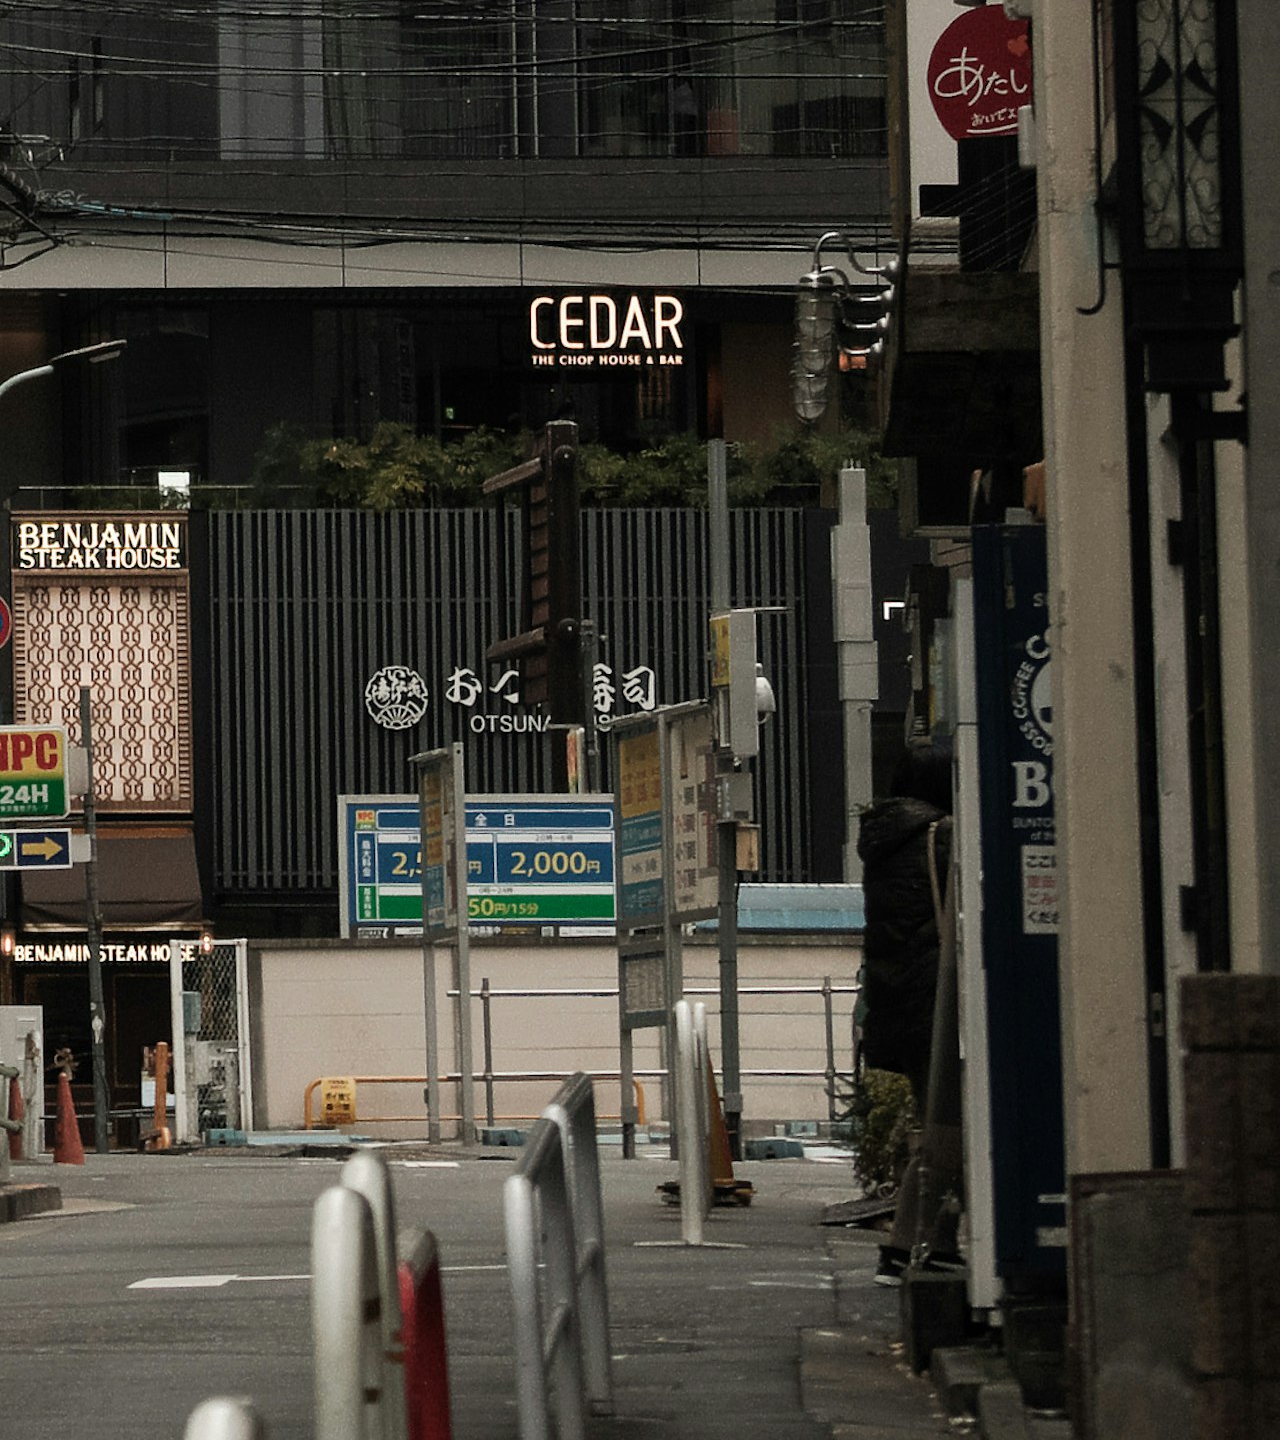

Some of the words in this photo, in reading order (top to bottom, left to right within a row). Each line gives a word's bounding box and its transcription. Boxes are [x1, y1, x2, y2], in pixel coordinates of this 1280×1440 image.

[529, 295, 683, 349] CEDAR
[532, 355, 555, 366] THE
[559, 355, 594, 366] CHOP
[599, 355, 641, 366] HOUSE
[659, 355, 683, 365] BAR
[18, 522, 180, 549] BENJAMIN
[19, 548, 100, 569] STEAK
[105, 548, 181, 569] HOUSE
[0, 783, 49, 805] 24H
[510, 851, 601, 878] 2,000円
[14, 944, 91, 962] BENJAMIN
[99, 944, 148, 962] STEAK
[151, 944, 196, 962] HOSE
